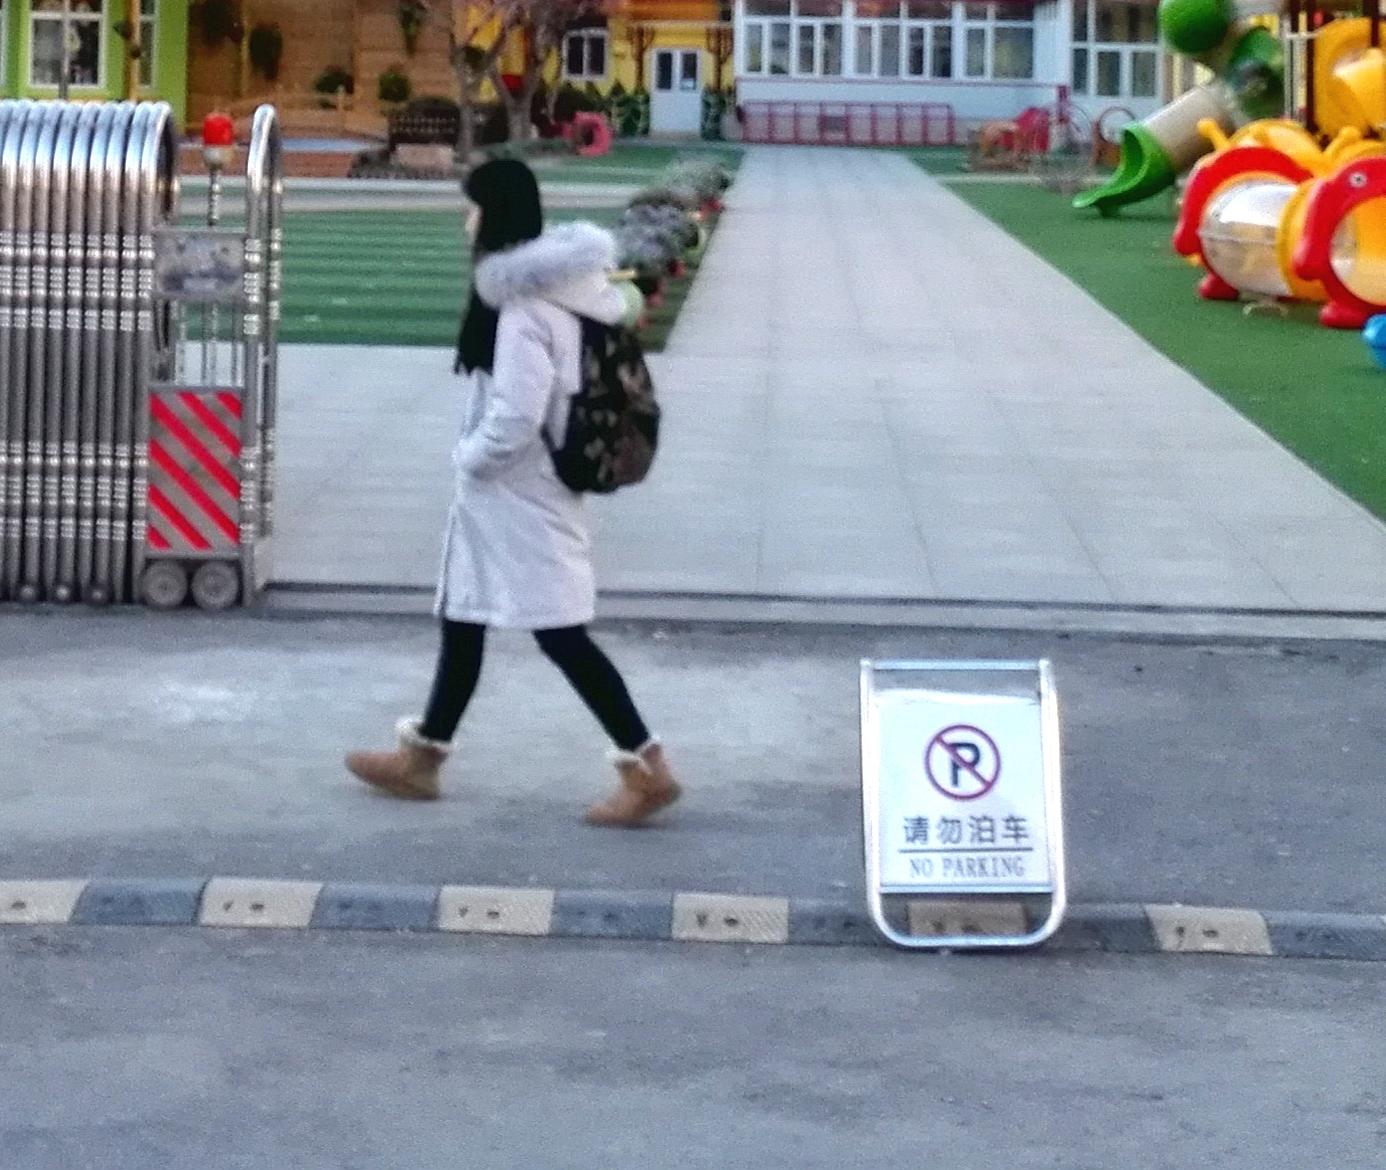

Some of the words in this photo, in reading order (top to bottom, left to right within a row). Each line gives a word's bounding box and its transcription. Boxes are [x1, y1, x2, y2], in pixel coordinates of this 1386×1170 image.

[903, 815, 1029, 844] 请勿泊车
[910, 858, 934, 878] NO
[942, 856, 1025, 878] PARKING
